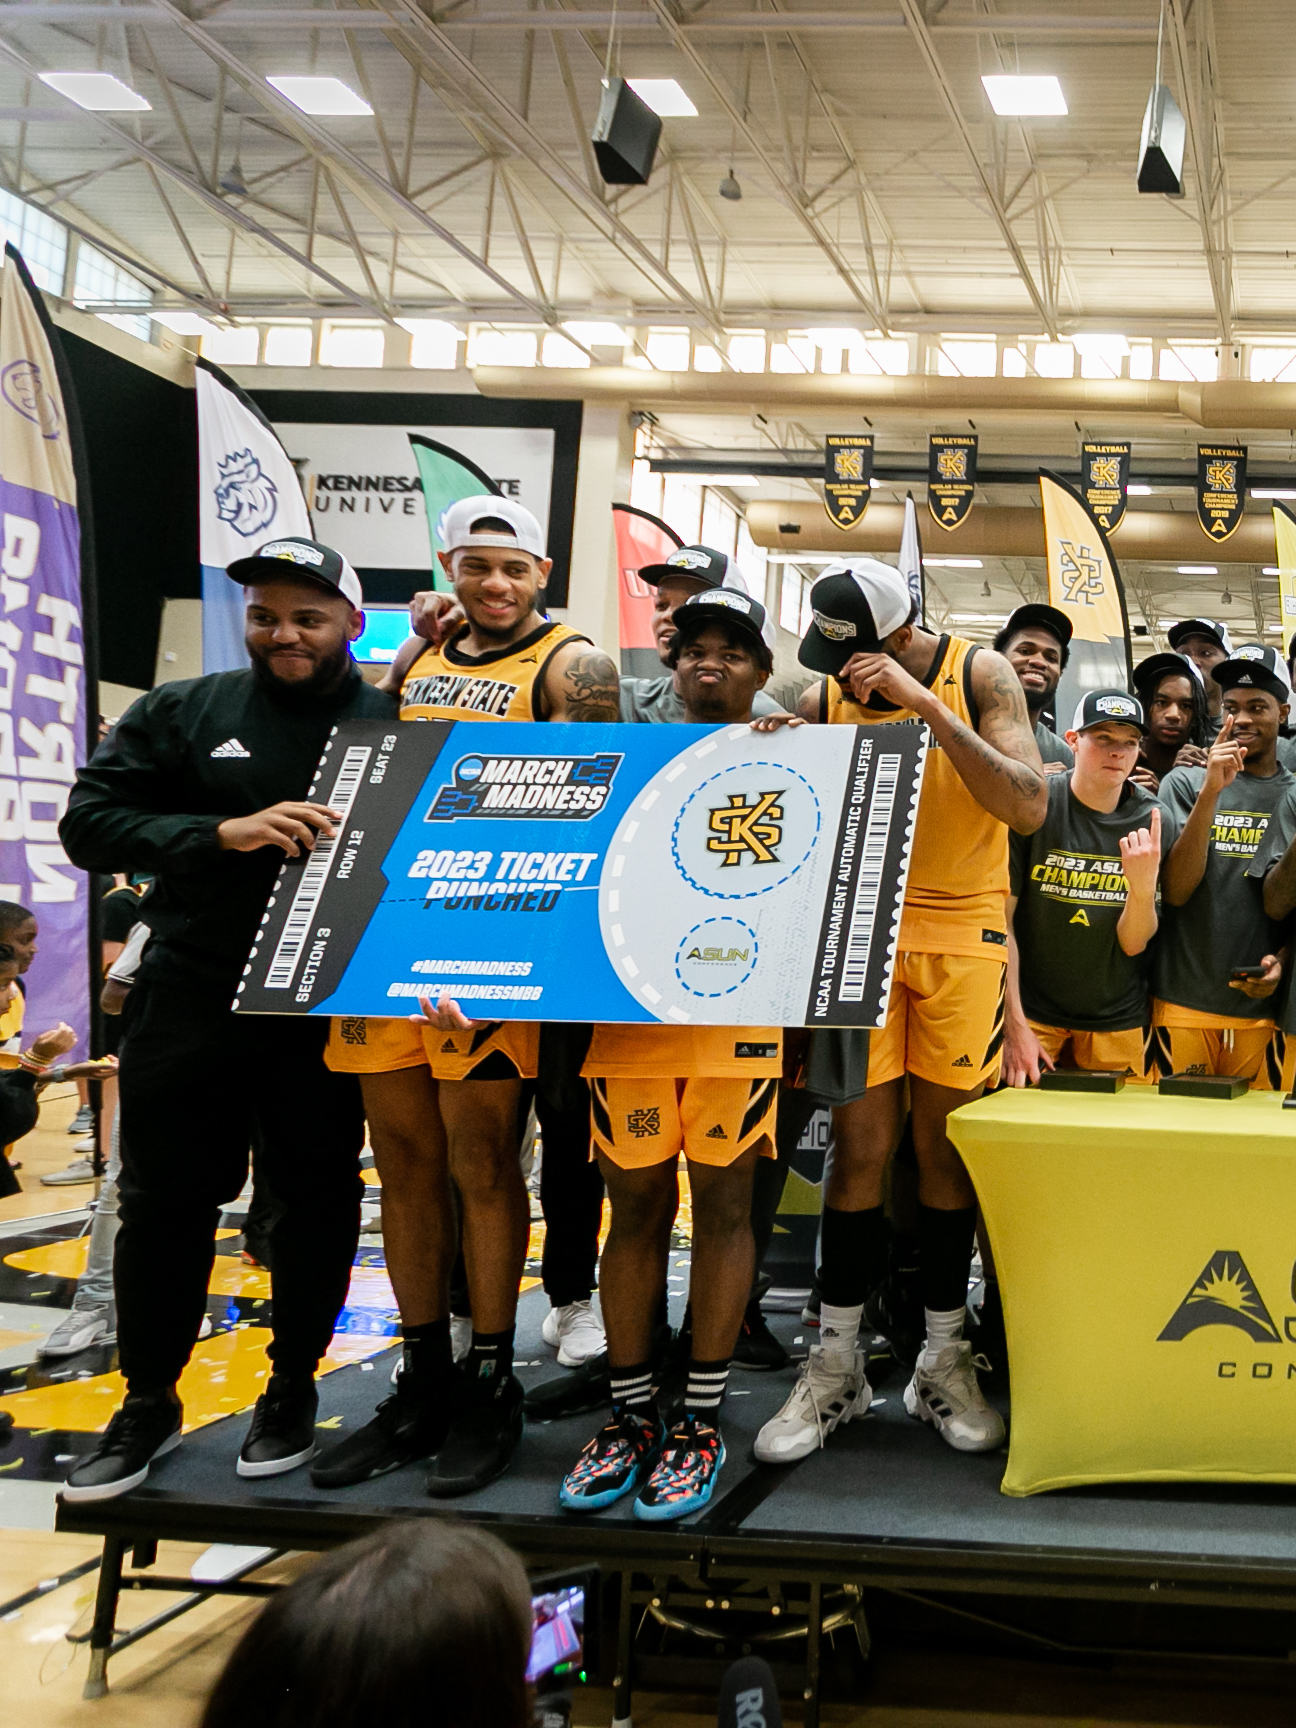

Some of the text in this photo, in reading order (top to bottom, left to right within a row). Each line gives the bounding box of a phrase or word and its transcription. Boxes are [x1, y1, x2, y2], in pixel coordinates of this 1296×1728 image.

[931, 437, 976, 446] VOLLEYBALL
[1084, 444, 1128, 453] VOLLEYBALL
[1200, 448, 1244, 457] VOLLEYBALL
[316, 474, 425, 493] KENNESA
[314, 495, 418, 515] UNIVE
[1098, 699, 1136, 713] CHAMPIONS
[369, 734, 398, 784] SEAT 23
[478, 760, 574, 784] MARCH
[482, 784, 608, 810] MADNESS
[1214, 814, 1253, 828] 2023
[336, 830, 364, 879] ROW 12
[1214, 842, 1240, 852] MEN'S
[407, 850, 598, 881] 2023 TICKET
[1044, 854, 1124, 874] 2023 ASU
[814, 738, 874, 1017] NCAA TOURNAMENT AUTOMATIC QUALIFIER
[1030, 864, 1131, 892] CHAMPION
[423, 880, 563, 912] PUNCHED
[1040, 884, 1129, 902] MEN'S BASKETBAL
[686, 947, 750, 962] ASUN
[295, 928, 331, 1003] SECTION 3
[410, 960, 534, 976] #MARCHMADNESS
[386, 982, 544, 1000] @MARCHMADNESSMBB
